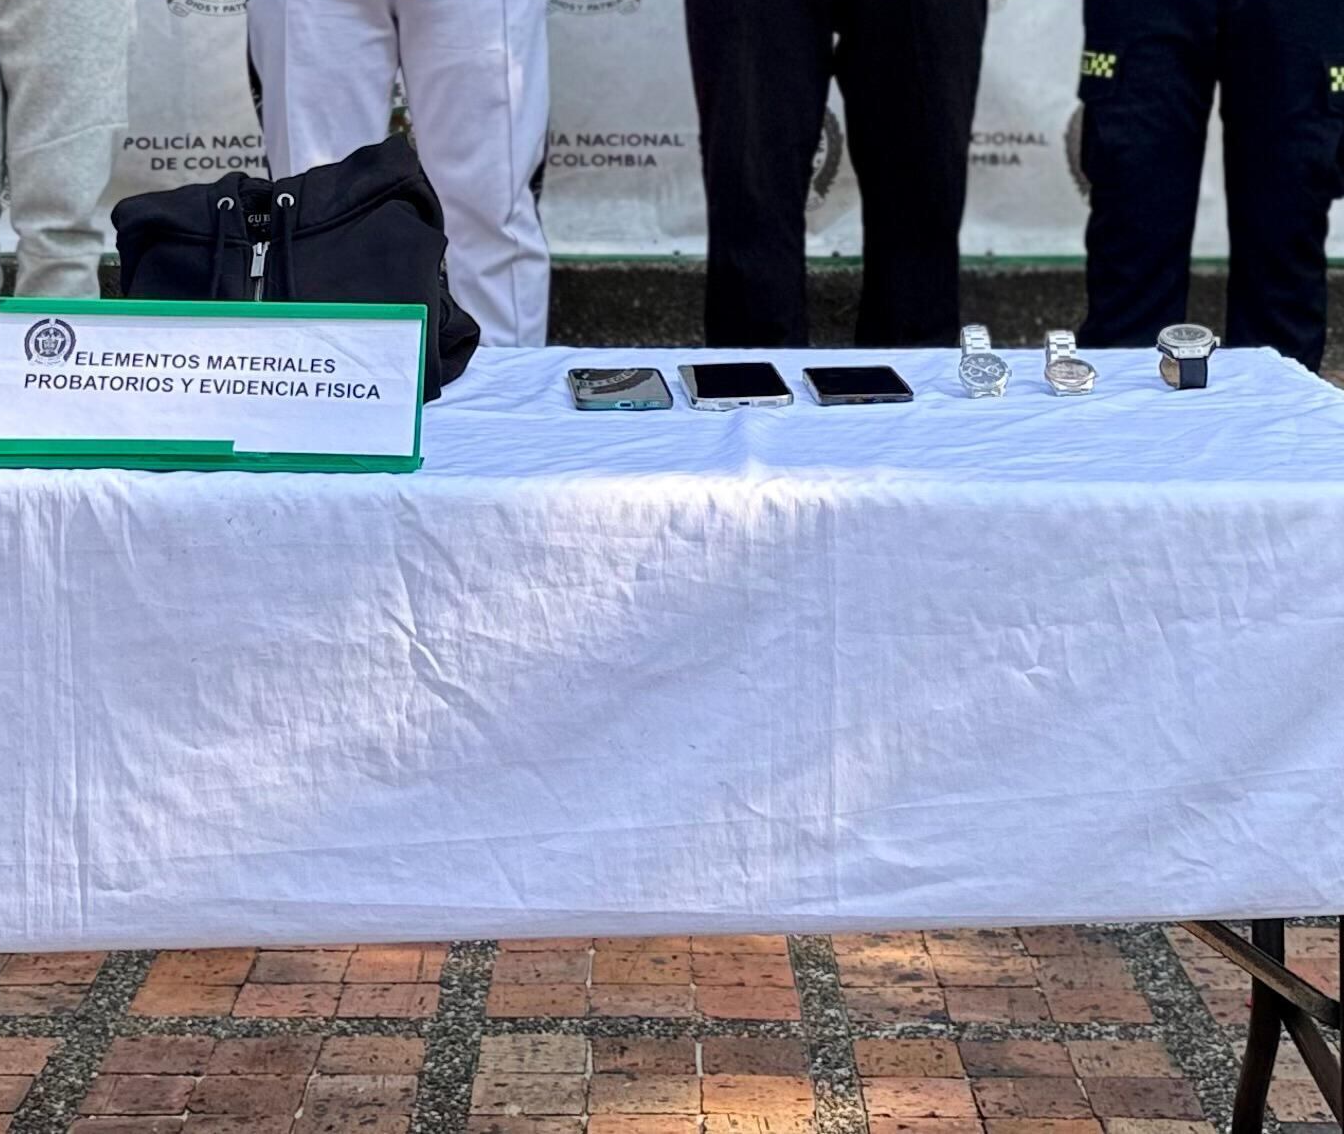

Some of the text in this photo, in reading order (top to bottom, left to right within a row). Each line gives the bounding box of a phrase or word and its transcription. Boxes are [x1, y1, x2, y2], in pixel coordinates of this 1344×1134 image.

[122, 132, 262, 151] POLICÍA NACI
[575, 133, 685, 147] NACIONAL
[972, 131, 1049, 147] CIONAL
[150, 155, 267, 171] DE COLOM
[548, 153, 657, 168] COLOMBIA
[74, 350, 336, 374] ELEMENTOS MATERIALES
[24, 373, 381, 400] PROBATORIOS Y EVIDENCIA FISICA
